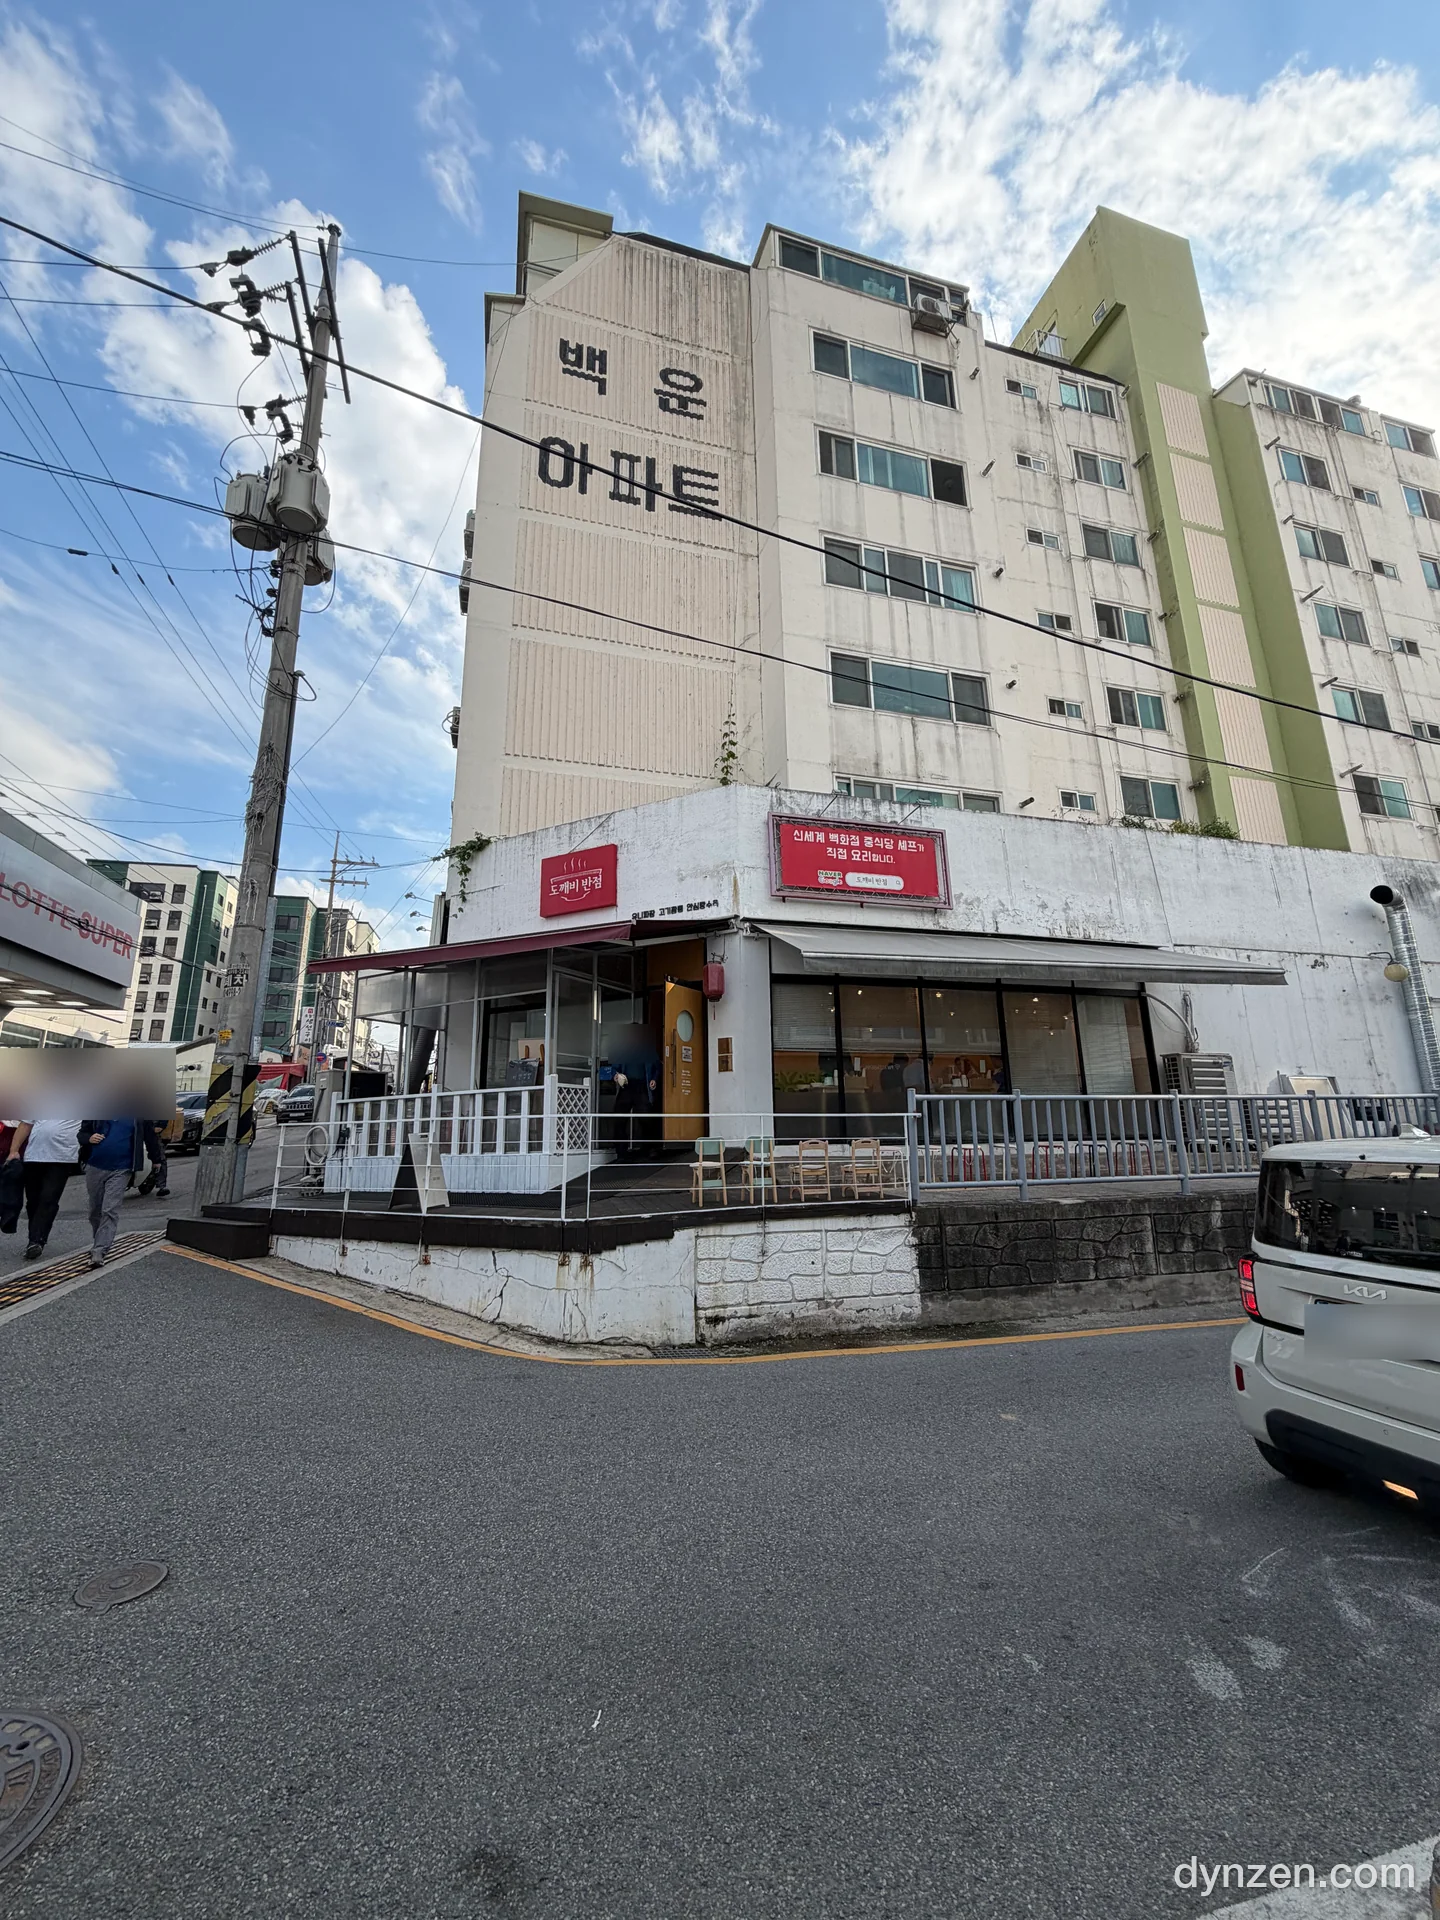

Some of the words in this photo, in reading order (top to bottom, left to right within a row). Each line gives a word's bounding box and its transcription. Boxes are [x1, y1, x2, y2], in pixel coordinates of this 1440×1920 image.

[538, 436, 722, 521] 아파트
[793, 829, 825, 843] 신세계
[828, 832, 860, 847] 백화점
[863, 836, 894, 850] 중식당
[826, 847, 847, 860] 직접
[851, 850, 896, 864] 요리합니다.
[818, 870, 842, 878] NAVER
[549, 879, 579, 896] 도깨비
[581, 874, 602, 892] 반점
[0, 872, 75, 931] LOTTE
[79, 911, 133, 960] SUPER
